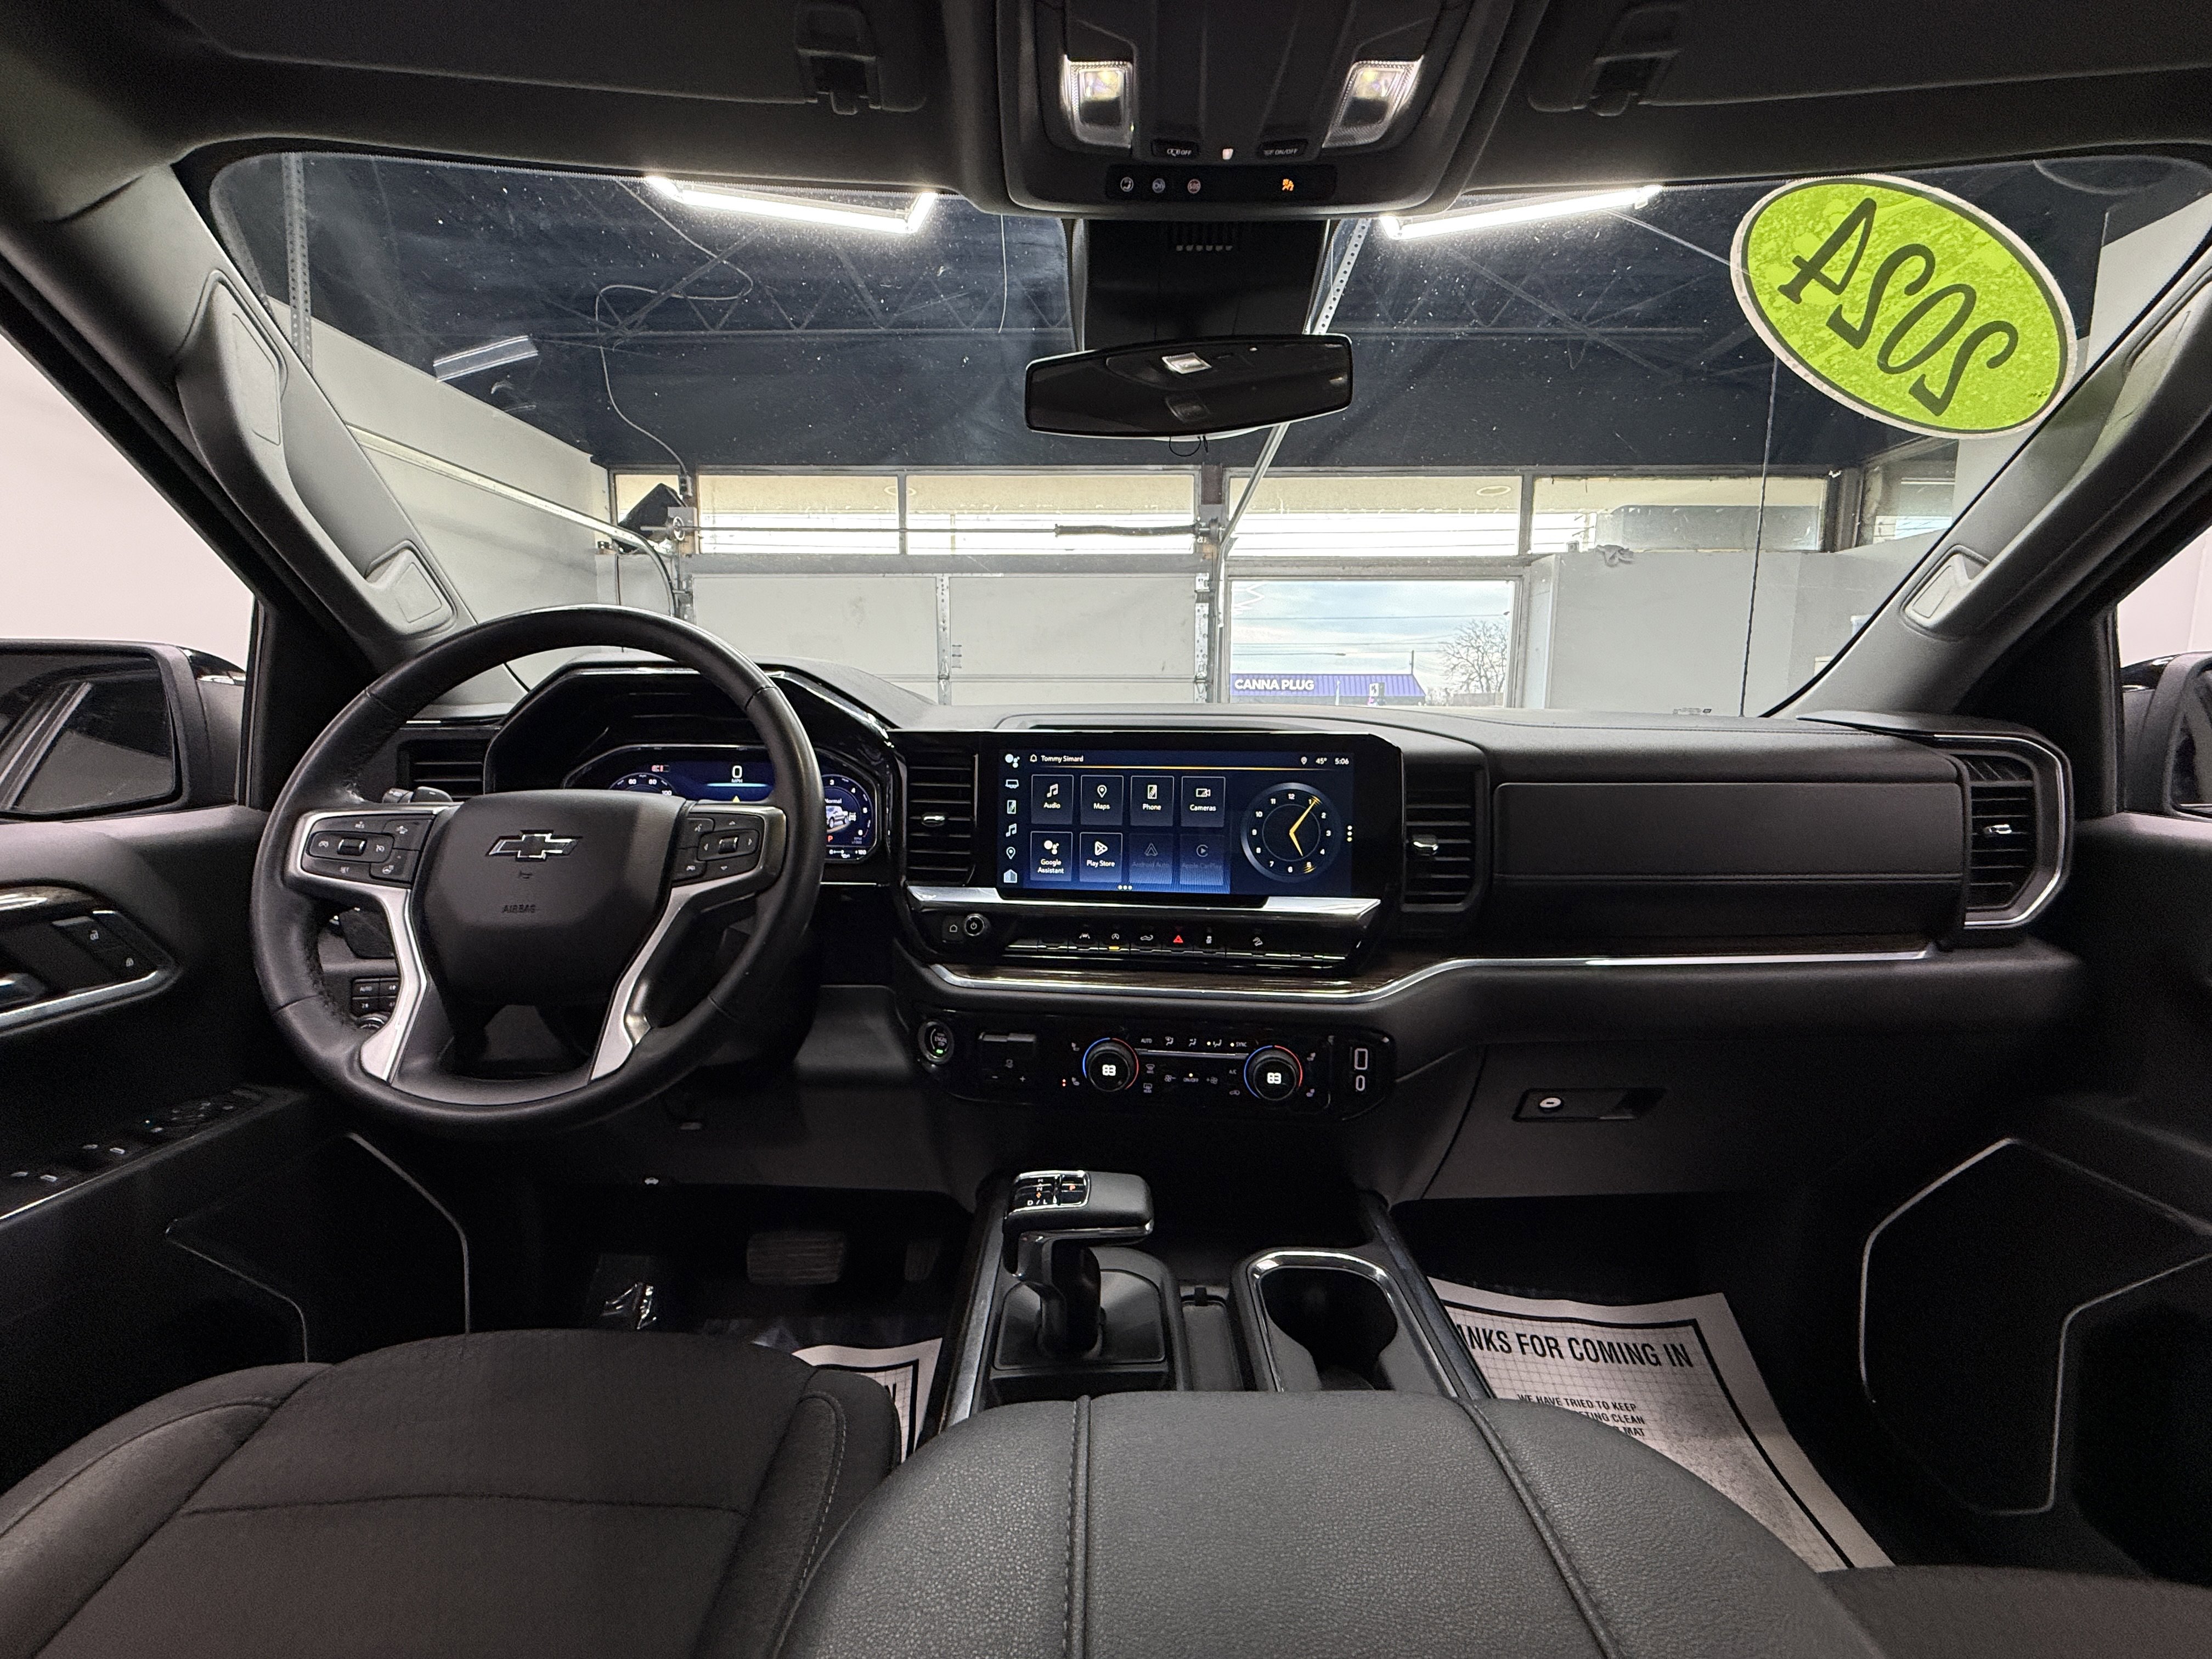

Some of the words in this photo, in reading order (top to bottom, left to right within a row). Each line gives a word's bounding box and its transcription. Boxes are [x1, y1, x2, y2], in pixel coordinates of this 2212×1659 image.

[1234, 679, 1280, 690] CANNA
[1281, 679, 1314, 690] PLUG
[1041, 755, 1062, 764] Tommy
[732, 765, 742, 778] 0
[1040, 859, 1062, 867] Google
[1086, 860, 1098, 868] Play
[1516, 1332, 1565, 1360] FOR
[1567, 1337, 1662, 1367] COMING
[1663, 1343, 1694, 1368] IN
[1536, 1395, 1564, 1406] HAVE
[1564, 1398, 1594, 1409] TRIED
[1595, 1400, 1610, 1410] TO
[1611, 1402, 1637, 1412] KEEP
[1611, 1413, 1645, 1425] CLEAN
[1623, 1426, 1645, 1437] MAT
